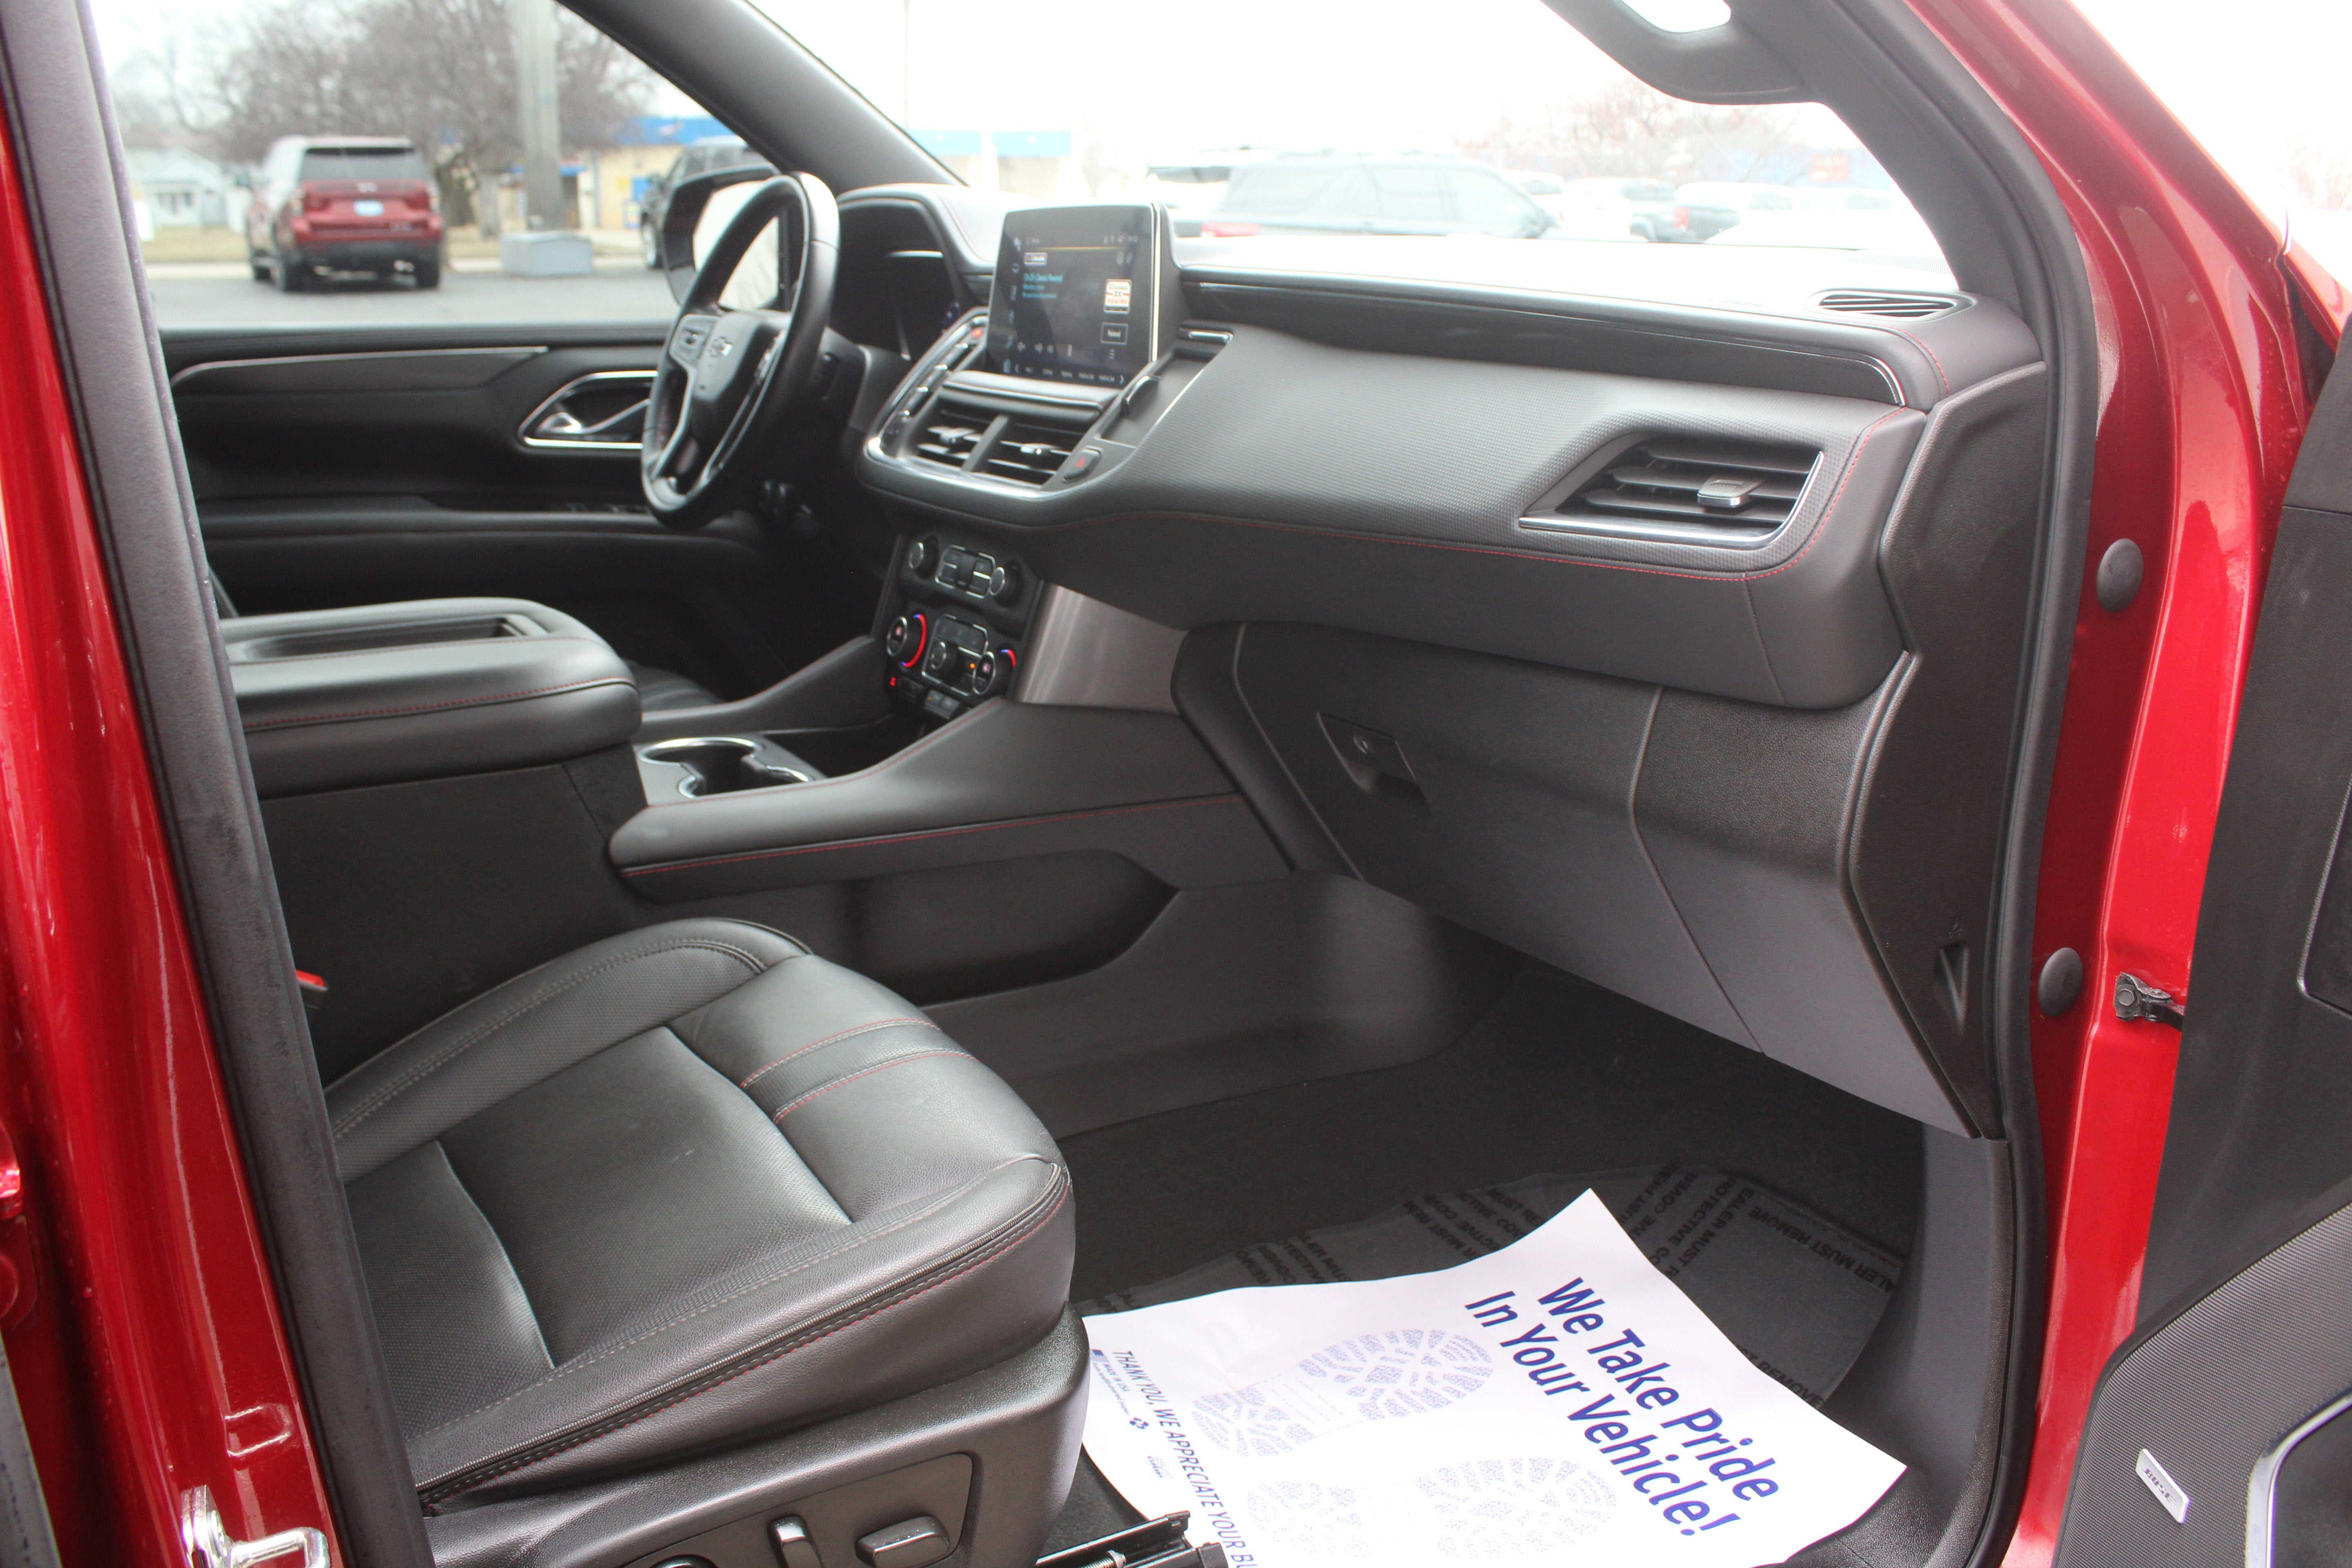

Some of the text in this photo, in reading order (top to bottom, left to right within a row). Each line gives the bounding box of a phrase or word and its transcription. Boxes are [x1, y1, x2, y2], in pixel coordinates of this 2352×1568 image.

[1655, 1172, 1698, 1214] COVER
[1428, 1223, 1466, 1250] MUST
[1748, 1206, 1812, 1244] REMOVE
[1678, 1229, 1716, 1266] MUST
[1811, 1240, 1855, 1270] MUST
[1112, 1350, 1149, 1381] THANK
[1137, 1380, 1168, 1405] YOU,
[1538, 1276, 1780, 1501] We Take Pride
[1154, 1409, 1180, 1428] WE
[1464, 1290, 1742, 1536] In Your Vehicle!
[1163, 1431, 1224, 1508] APPRECIATE
[1207, 1511, 1246, 1548] YOUR
